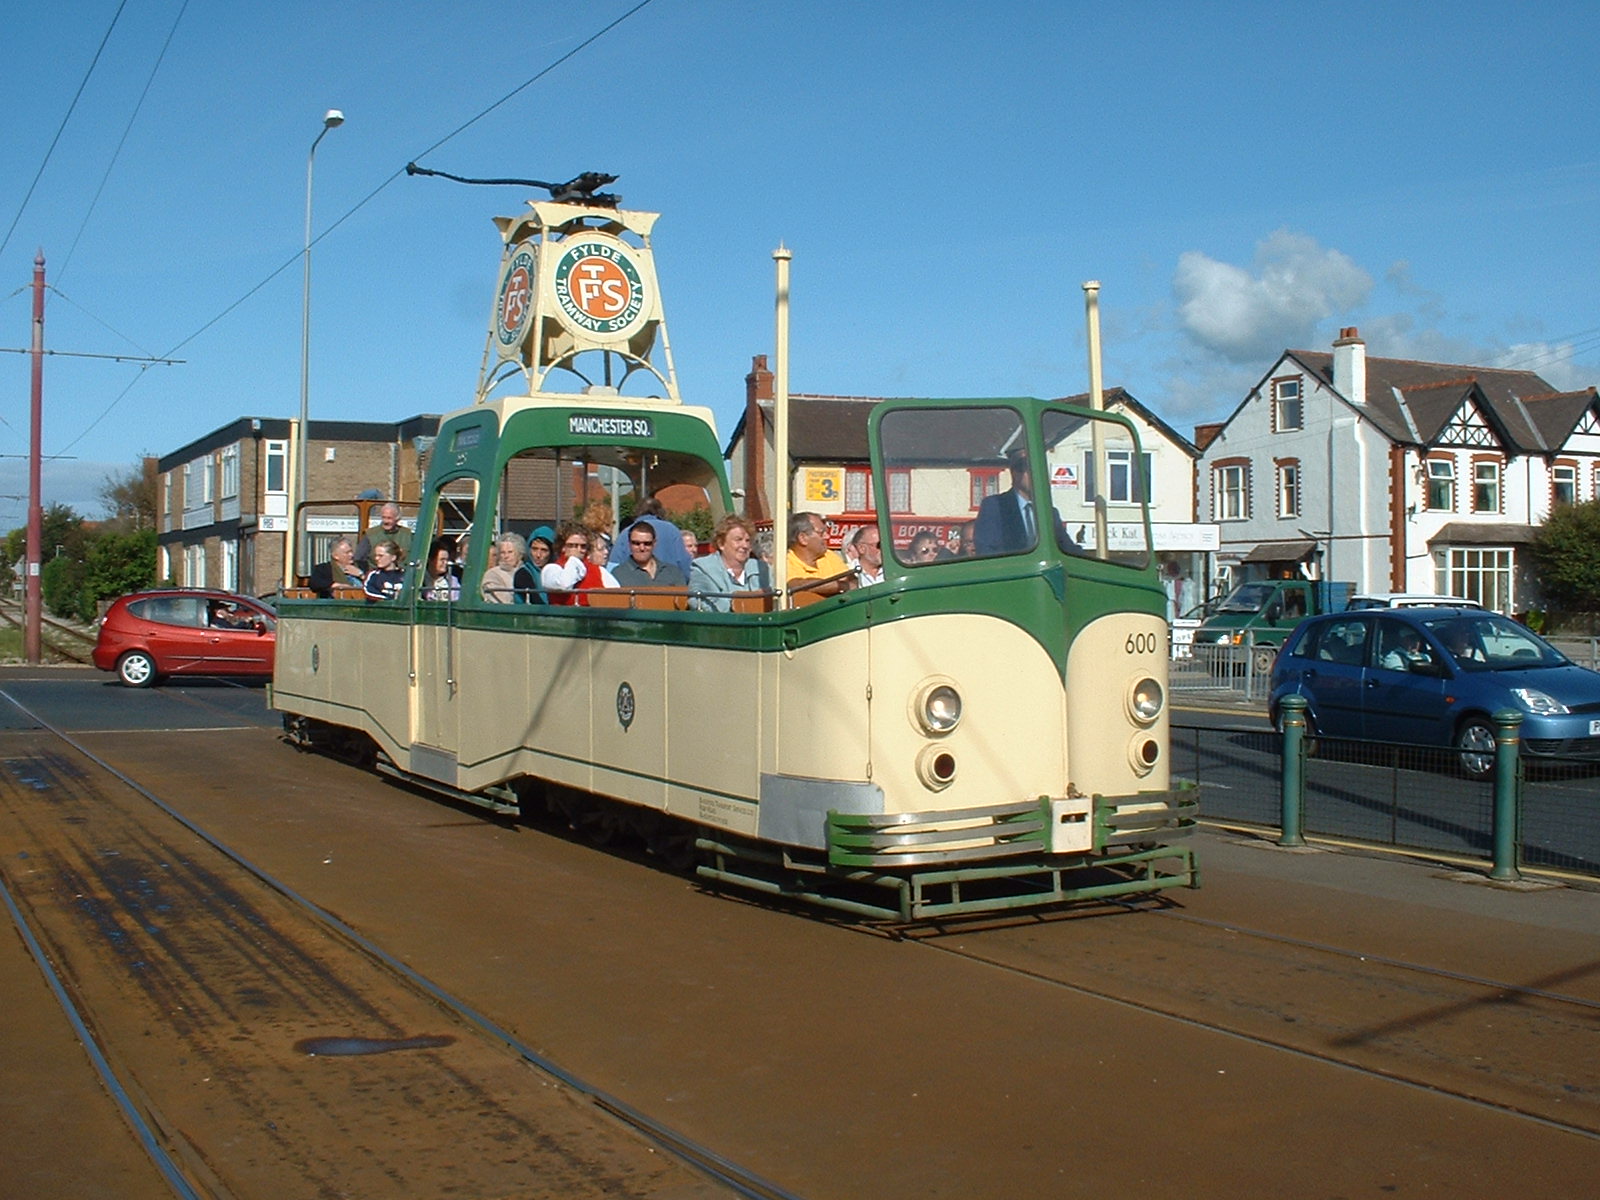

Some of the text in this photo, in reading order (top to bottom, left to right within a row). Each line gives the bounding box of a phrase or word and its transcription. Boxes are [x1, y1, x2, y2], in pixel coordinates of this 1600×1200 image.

[571, 245, 622, 263] FYLDE
[557, 278, 602, 331] TRAMWAY
[608, 281, 643, 331] SOCIETY
[569, 417, 633, 435] MANCHESTER
[1125, 633, 1156, 654] 600
